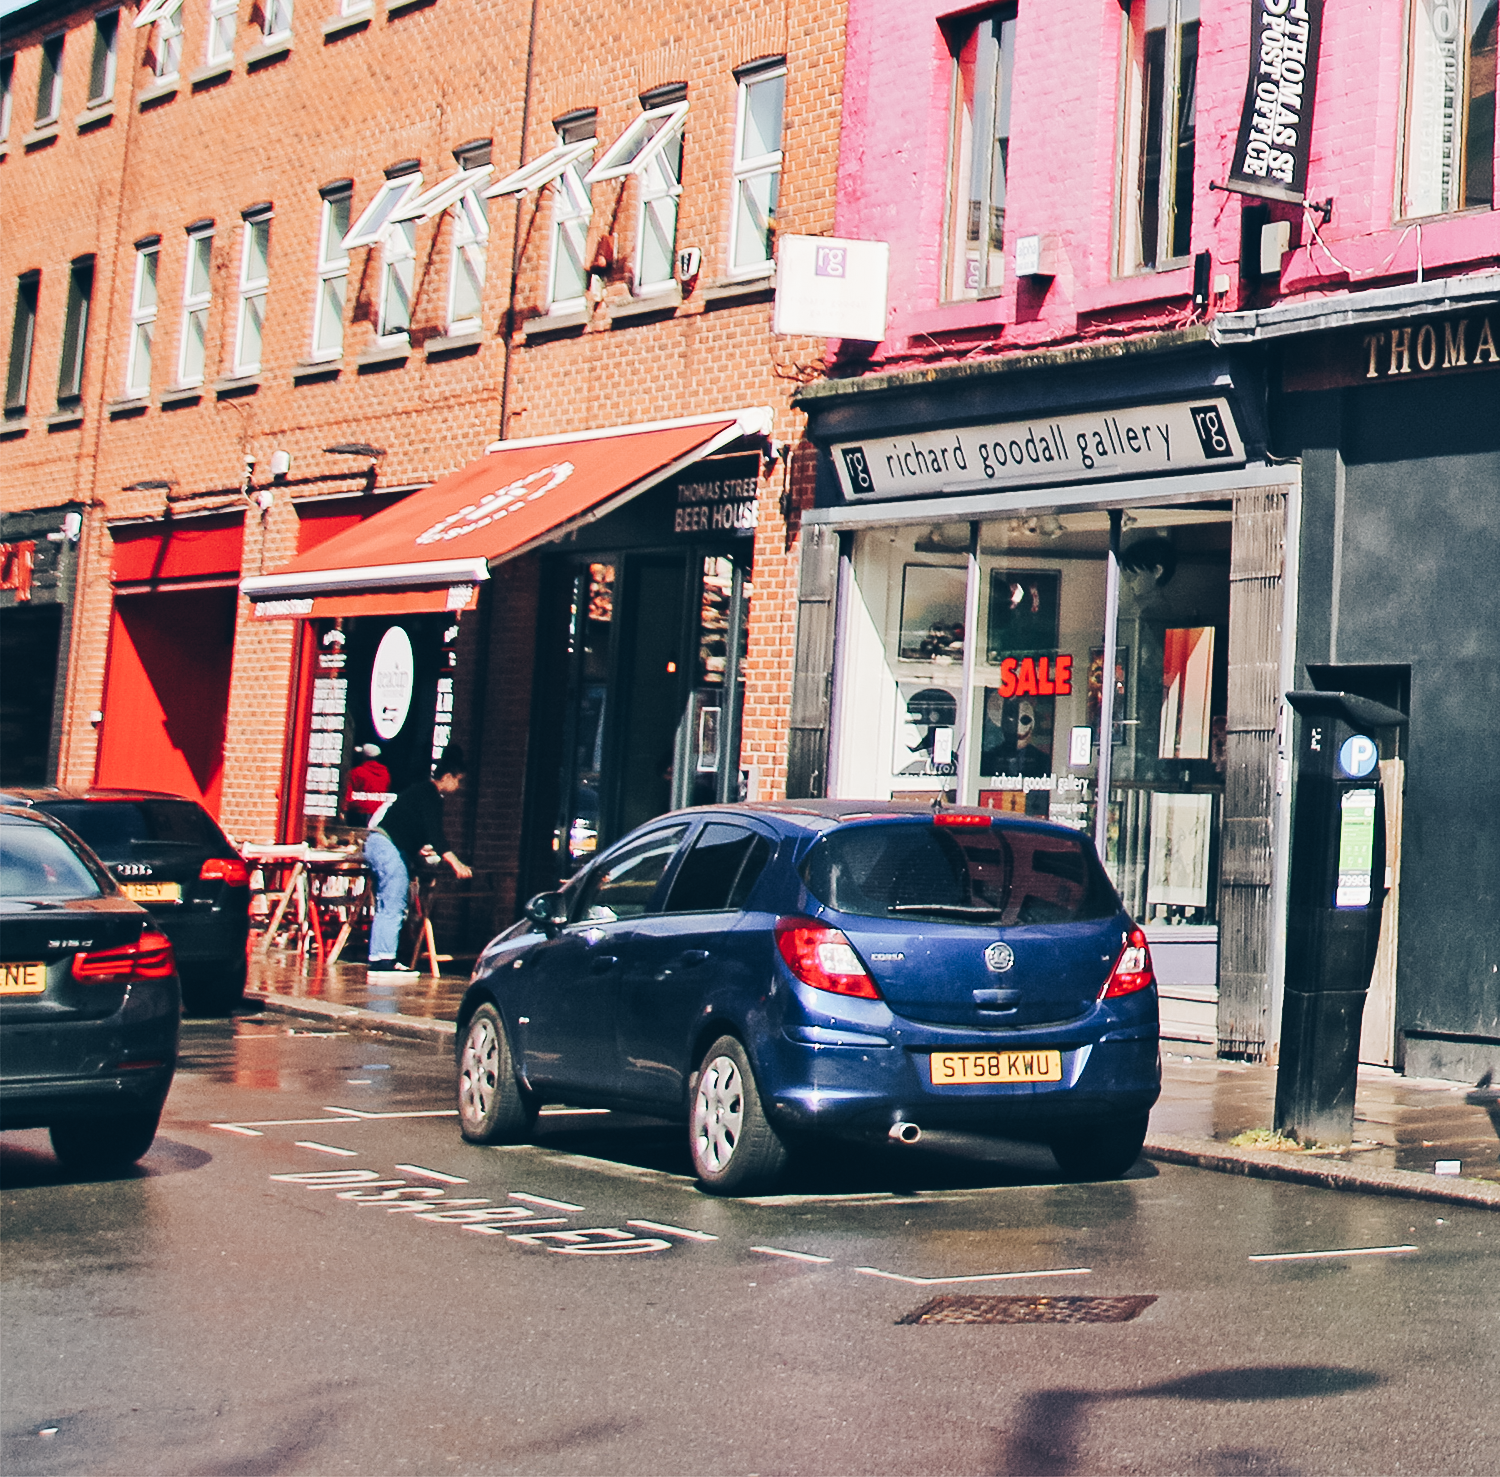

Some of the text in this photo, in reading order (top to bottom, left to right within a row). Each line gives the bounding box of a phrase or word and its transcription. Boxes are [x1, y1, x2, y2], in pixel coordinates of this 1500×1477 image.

[1243, 11, 1286, 178] POST OFFICE
[1271, 20, 1310, 148] THOMAS
[818, 247, 845, 275] rg
[846, 411, 1228, 488] rg richard goodall gallery rg
[677, 477, 760, 502] THOMAS STREE
[674, 499, 759, 533] BEER HOUSE
[997, 654, 1073, 698] SALE
[1350, 737, 1373, 775] P
[0, 963, 38, 986] NE
[942, 1053, 1050, 1078] ST58 KWU
[270, 1168, 672, 1256] DISABLED
